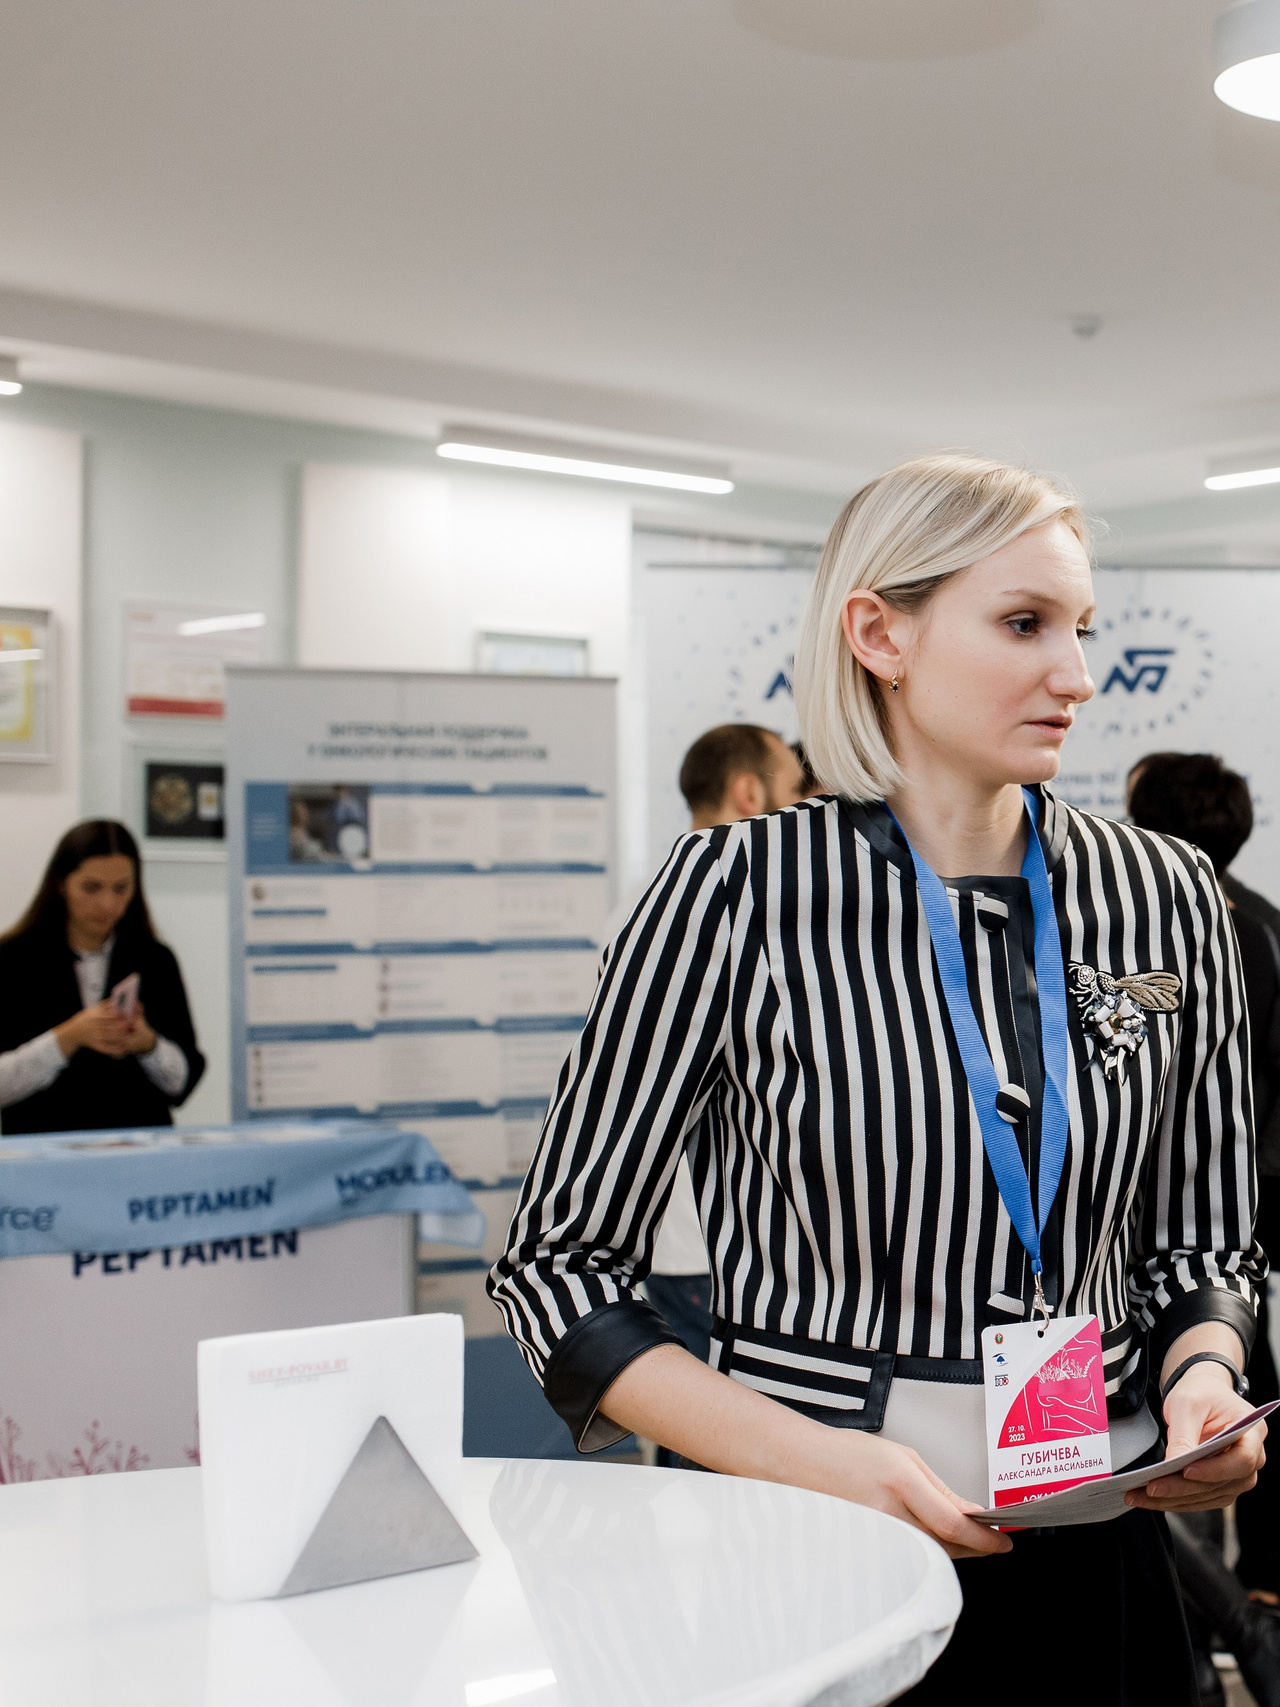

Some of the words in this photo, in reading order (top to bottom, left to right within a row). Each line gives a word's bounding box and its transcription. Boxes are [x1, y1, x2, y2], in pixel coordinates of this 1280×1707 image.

[128, 1182, 274, 1223] PEPTAMEN
[1008, 1432, 1026, 1442] 2023
[1021, 1445, 1081, 1466] ГУБИЧЕВА
[997, 1466, 1052, 1482] АЛЕКСАНДРА
[1054, 1458, 1104, 1473] ВАСИЛЬЕВНА
